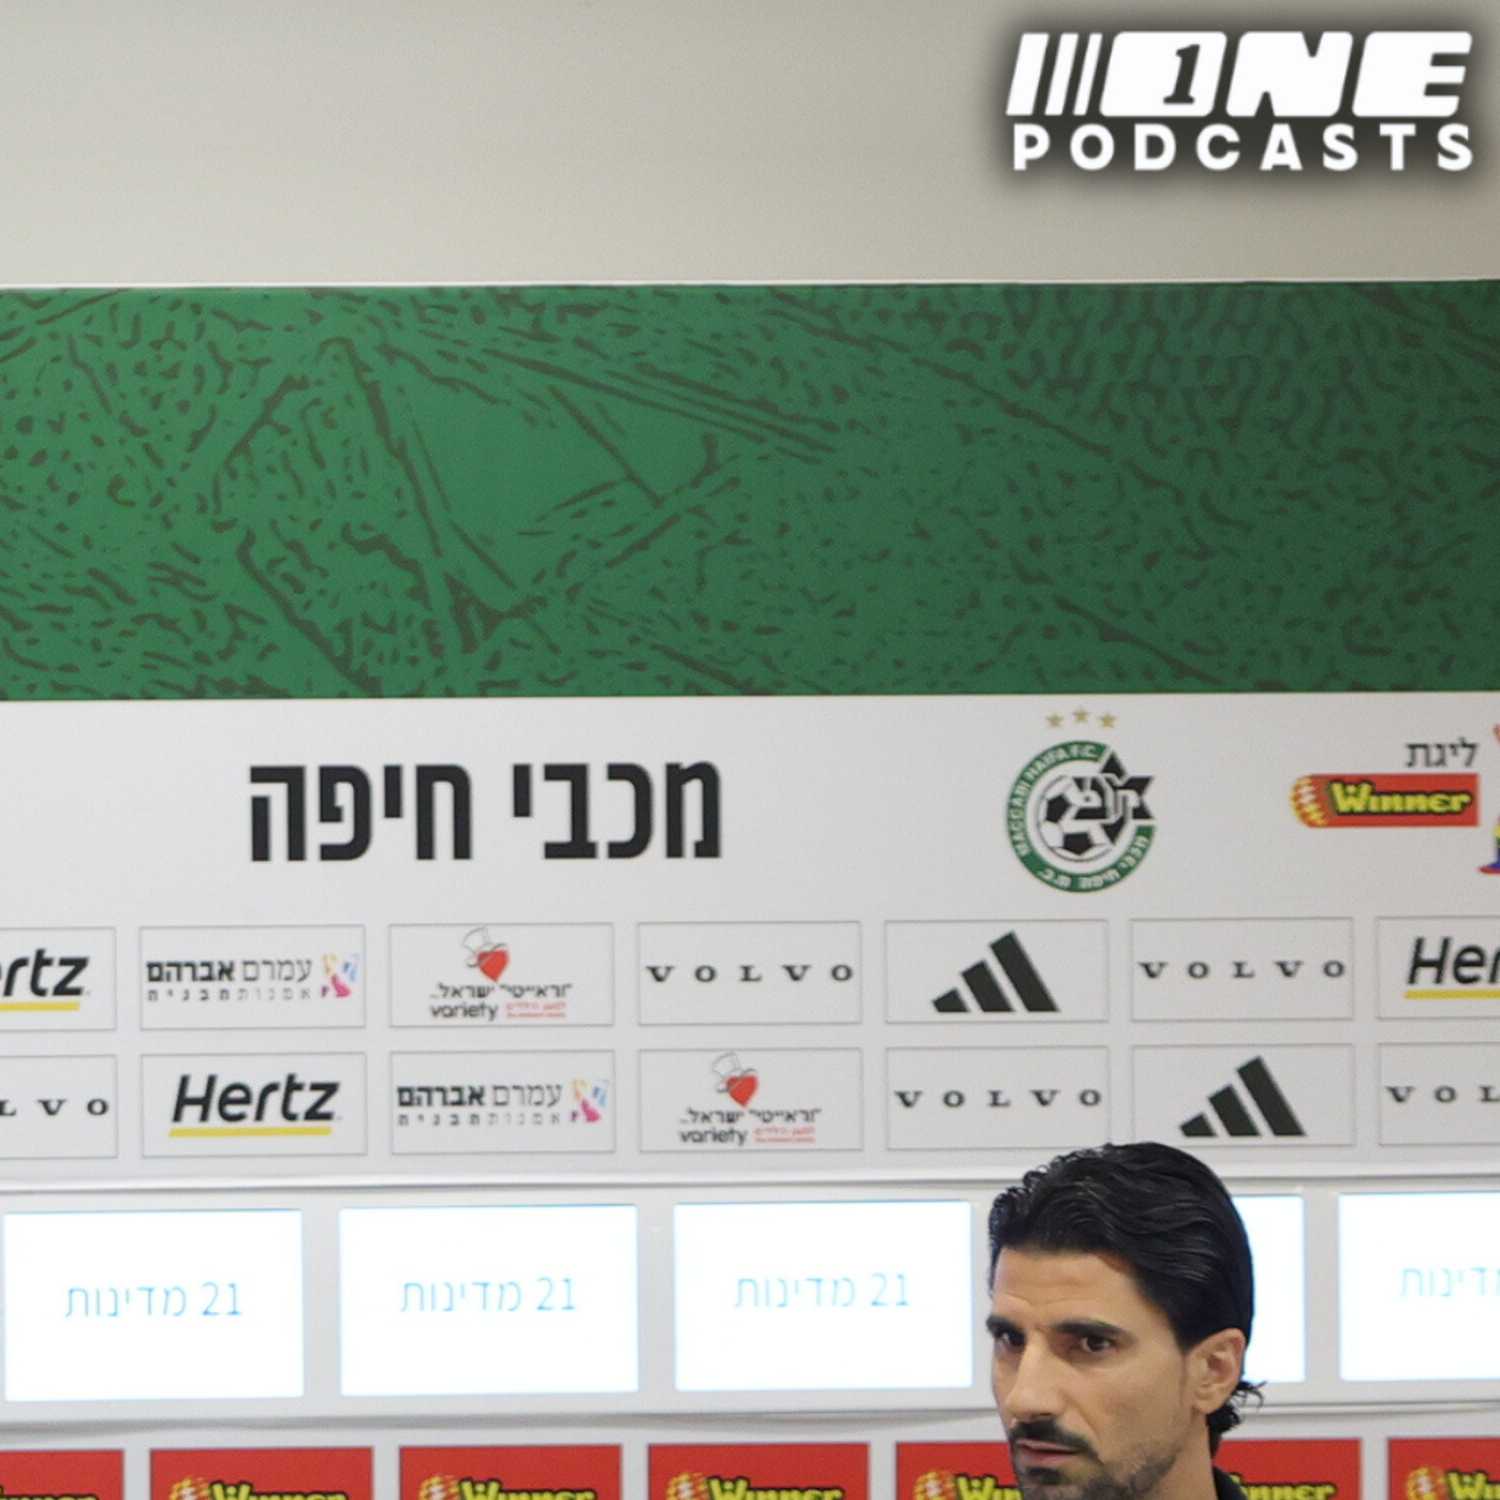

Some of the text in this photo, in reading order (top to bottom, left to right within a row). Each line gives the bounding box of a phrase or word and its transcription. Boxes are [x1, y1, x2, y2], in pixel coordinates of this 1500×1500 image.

[1405, 737, 1479, 769] ליגת
[1328, 779, 1473, 814] Winner
[250, 761, 722, 862] מכבי חיפה
[146, 959, 313, 983] עמרם אברהם
[645, 964, 854, 984] VOLVO
[1138, 959, 1346, 980] VOLVO
[430, 1000, 499, 1021] variety
[171, 1072, 341, 1124] Hertz
[396, 1084, 563, 1108] עמרם אברהם
[894, 1088, 1102, 1109] VOLVO
[1385, 1084, 1500, 1103] VOL
[64, 1282, 242, 1318] 21 מדינות
[399, 1277, 577, 1313] 21 מדינות
[734, 1272, 909, 1308] 21 מדינות
